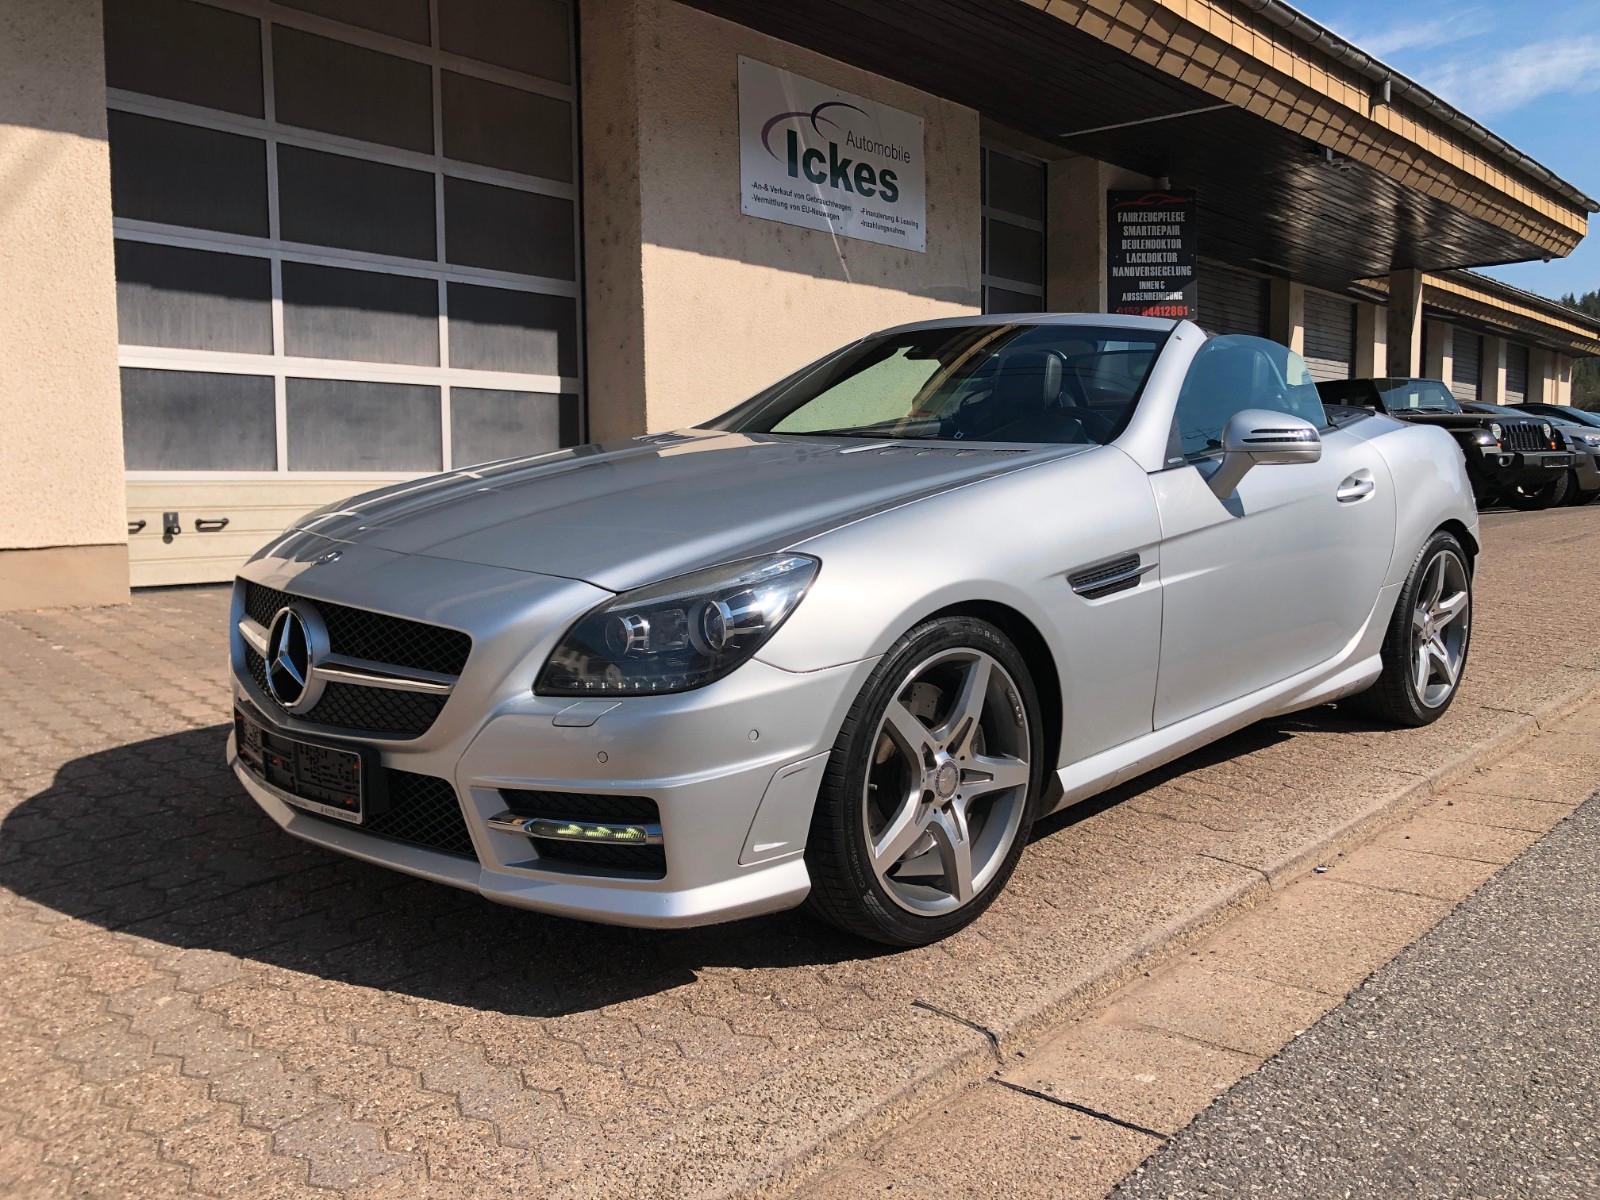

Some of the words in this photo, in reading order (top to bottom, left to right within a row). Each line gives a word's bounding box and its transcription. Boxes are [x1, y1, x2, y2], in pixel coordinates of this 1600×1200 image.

[846, 130, 910, 163] Automobile
[787, 129, 898, 202] Ickes
[769, 184, 792, 197] Verkauf
[793, 192, 805, 200] von
[789, 203, 801, 211] von
[1118, 212, 1185, 222] FAHRZEUGPFLEGE
[1123, 225, 1180, 236] SMARTREPAIR
[1122, 239, 1181, 249] BEULENDOKTOR
[1127, 253, 1177, 263] LACKDOKTOR
[1113, 266, 1191, 276] NANOVERSIEGELUNG
[1139, 281, 1159, 289] INNEN
[1122, 292, 1183, 301] AUSSENREINIGUNG
